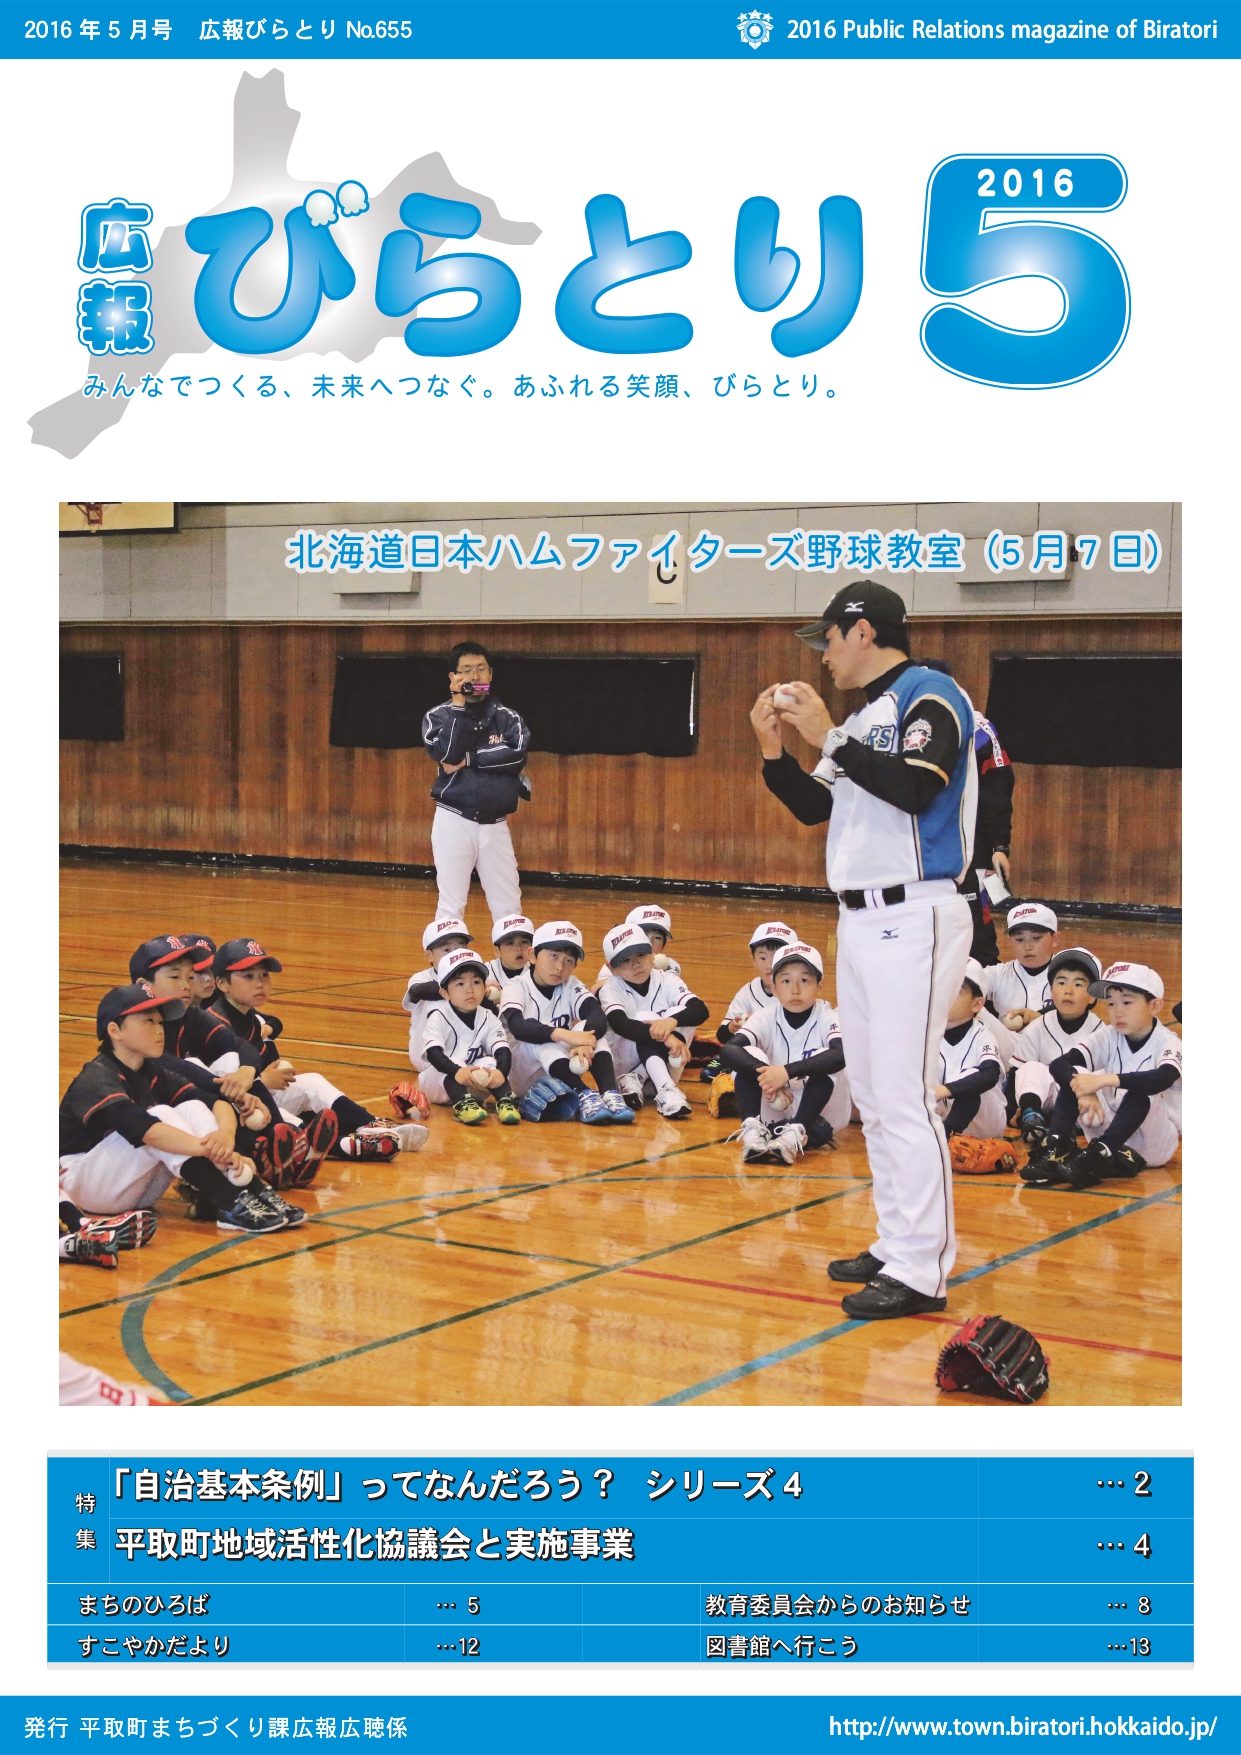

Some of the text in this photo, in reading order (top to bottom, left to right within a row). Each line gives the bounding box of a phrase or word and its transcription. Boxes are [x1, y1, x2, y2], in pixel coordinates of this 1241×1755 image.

[787, 18, 1218, 44] 2016 Public Relations magazine of Biratori
[977, 168, 1074, 198] 2016
[77, 198, 154, 356] 広報
[185, 180, 863, 358] びらとり
[919, 153, 1131, 390] 5
[1133, 1470, 1151, 1496] 2
[115, 1526, 636, 1562] 平取町地域活性化協議会と実施事業
[1133, 1533, 1152, 1558] 4
[79, 1593, 210, 1617] まちのひろば
[467, 1596, 480, 1615] 5
[705, 1593, 971, 1617] 教育委員会からのお知らせ
[1137, 1596, 1151, 1615] 8
[78, 1635, 229, 1658] すこやかだより
[706, 1634, 858, 1658] 図書館へ行こう
[24, 1716, 69, 1739] 発行
[829, 1714, 1218, 1741] http://www.town.biratori.hokkaido.jp/
